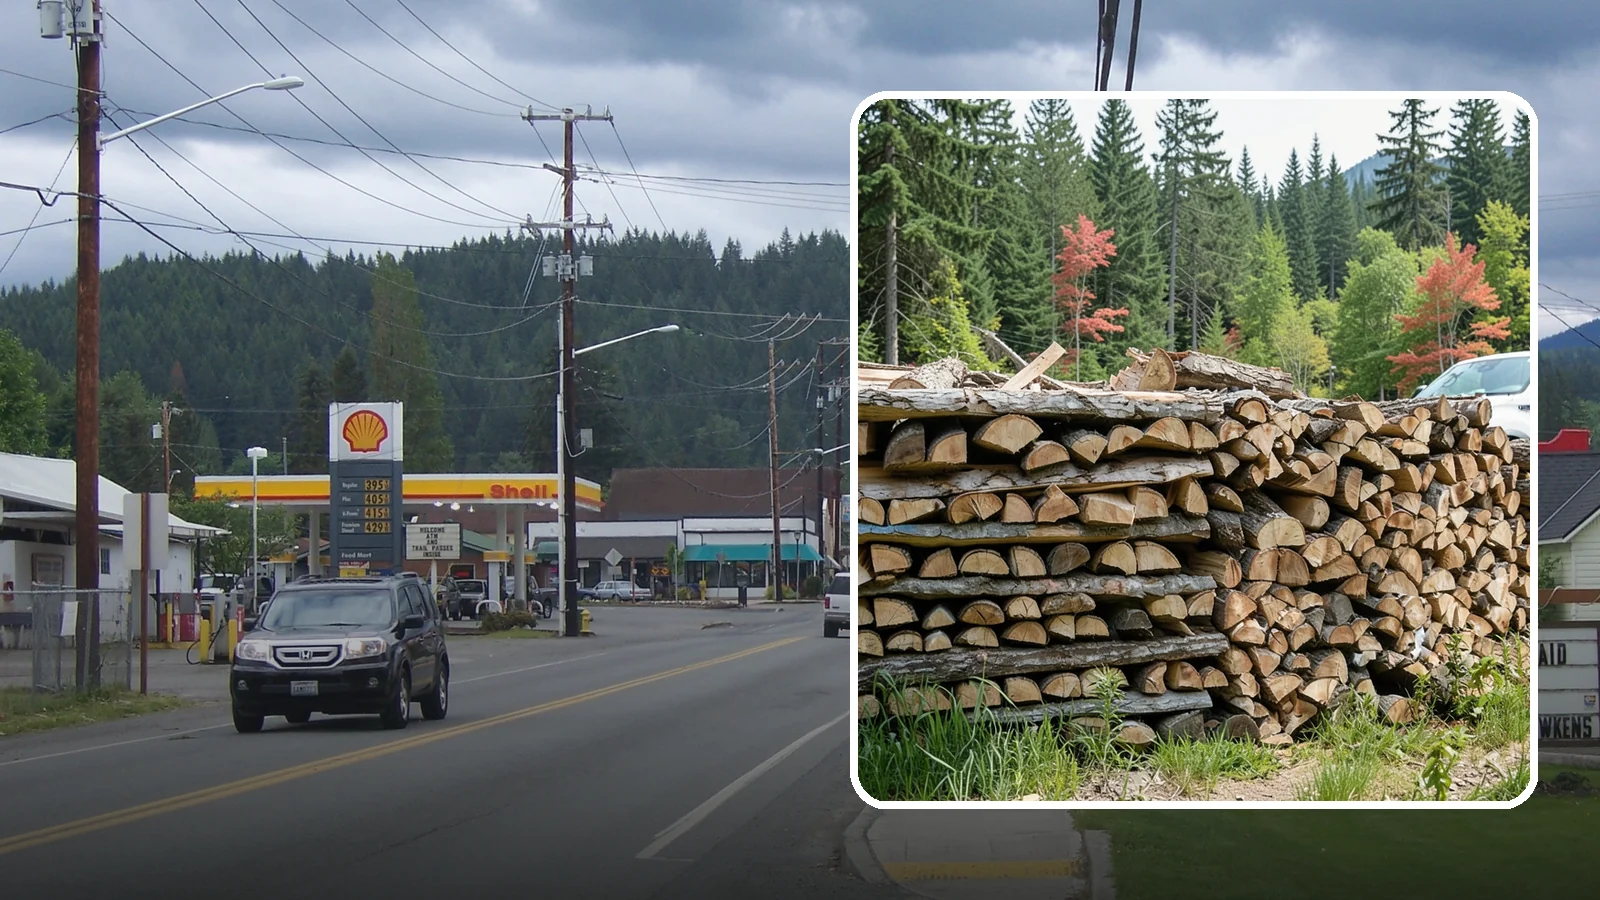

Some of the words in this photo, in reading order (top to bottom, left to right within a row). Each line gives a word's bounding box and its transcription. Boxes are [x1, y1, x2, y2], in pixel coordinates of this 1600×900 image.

[366, 479, 383, 490] 395
[490, 484, 547, 499] Shell
[366, 494, 383, 504] 405
[366, 508, 383, 518] 415
[366, 522, 383, 532] 429
